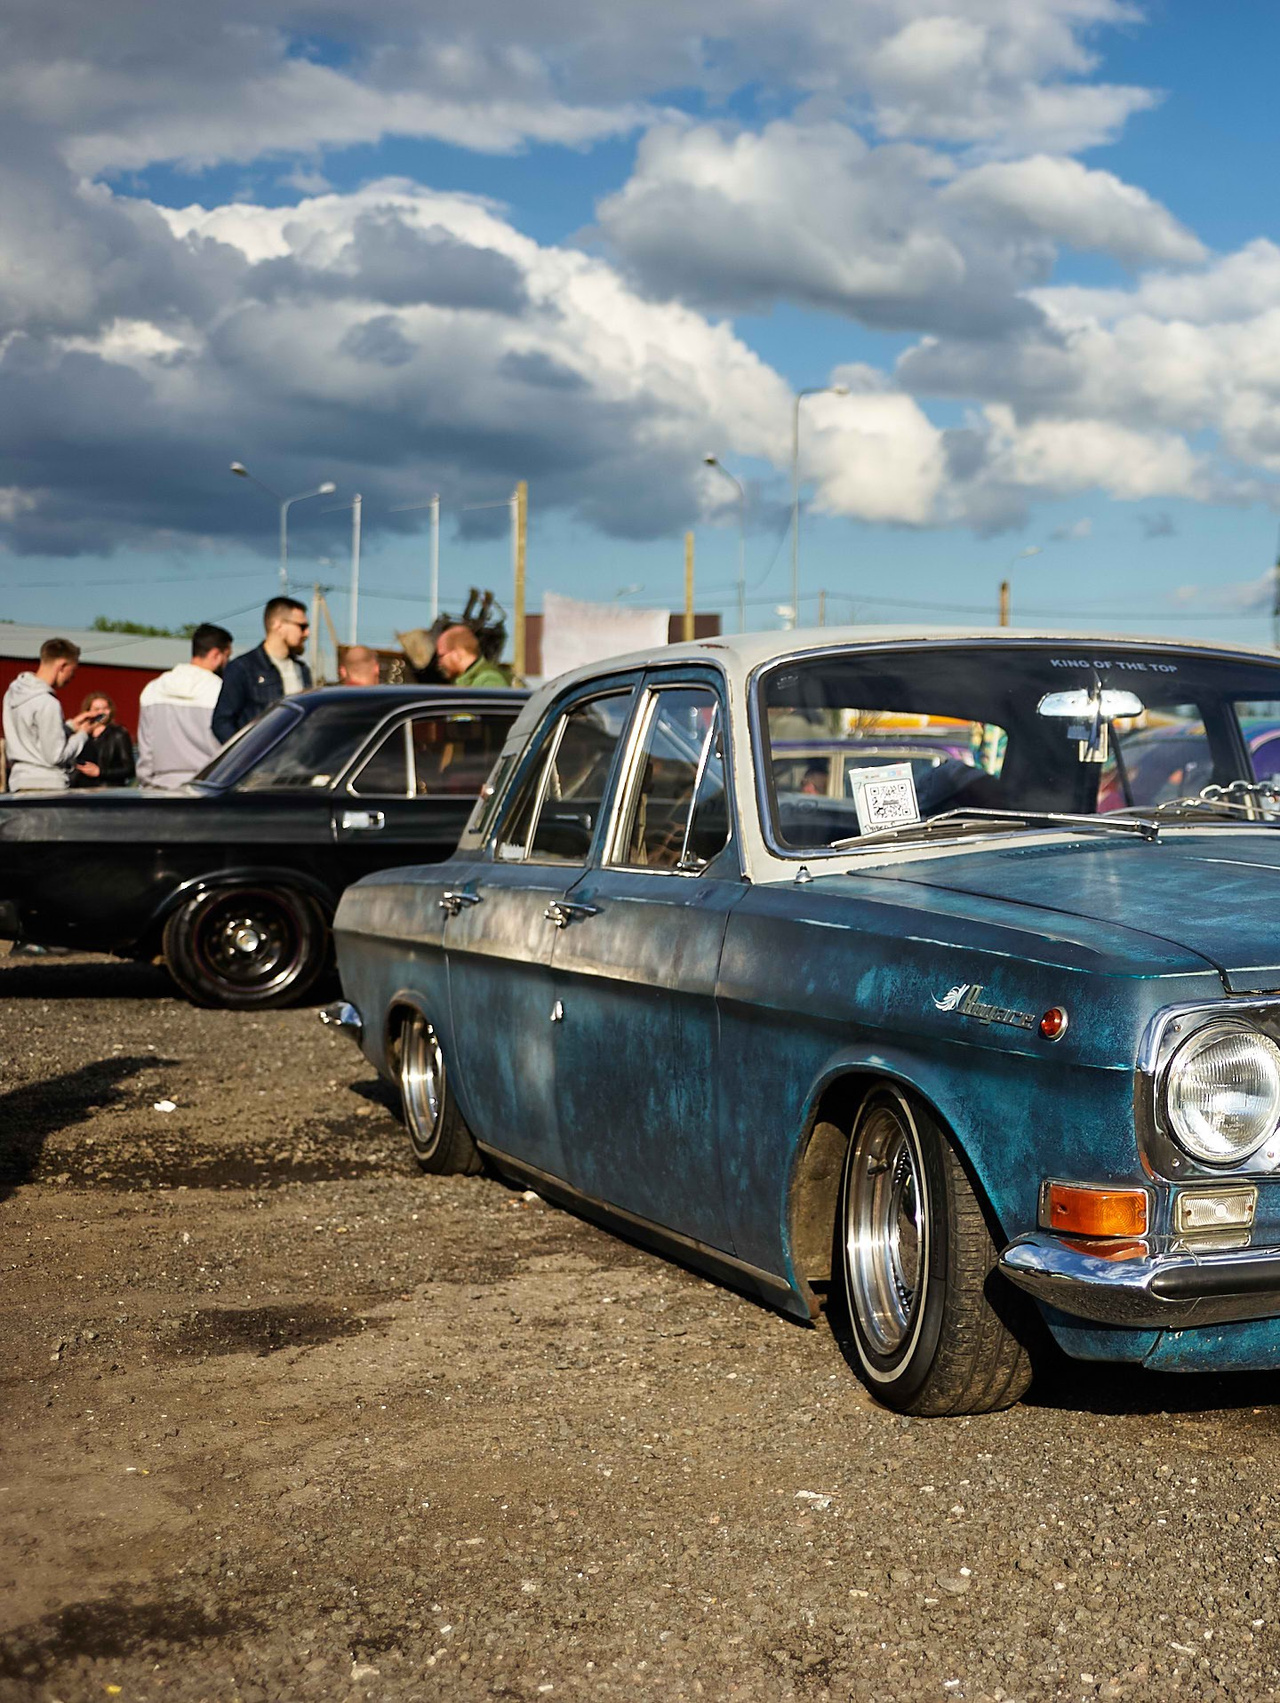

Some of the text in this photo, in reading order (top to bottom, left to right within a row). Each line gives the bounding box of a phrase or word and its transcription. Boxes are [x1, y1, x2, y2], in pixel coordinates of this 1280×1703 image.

[1051, 659, 1178, 673] KING OF THE TOP
